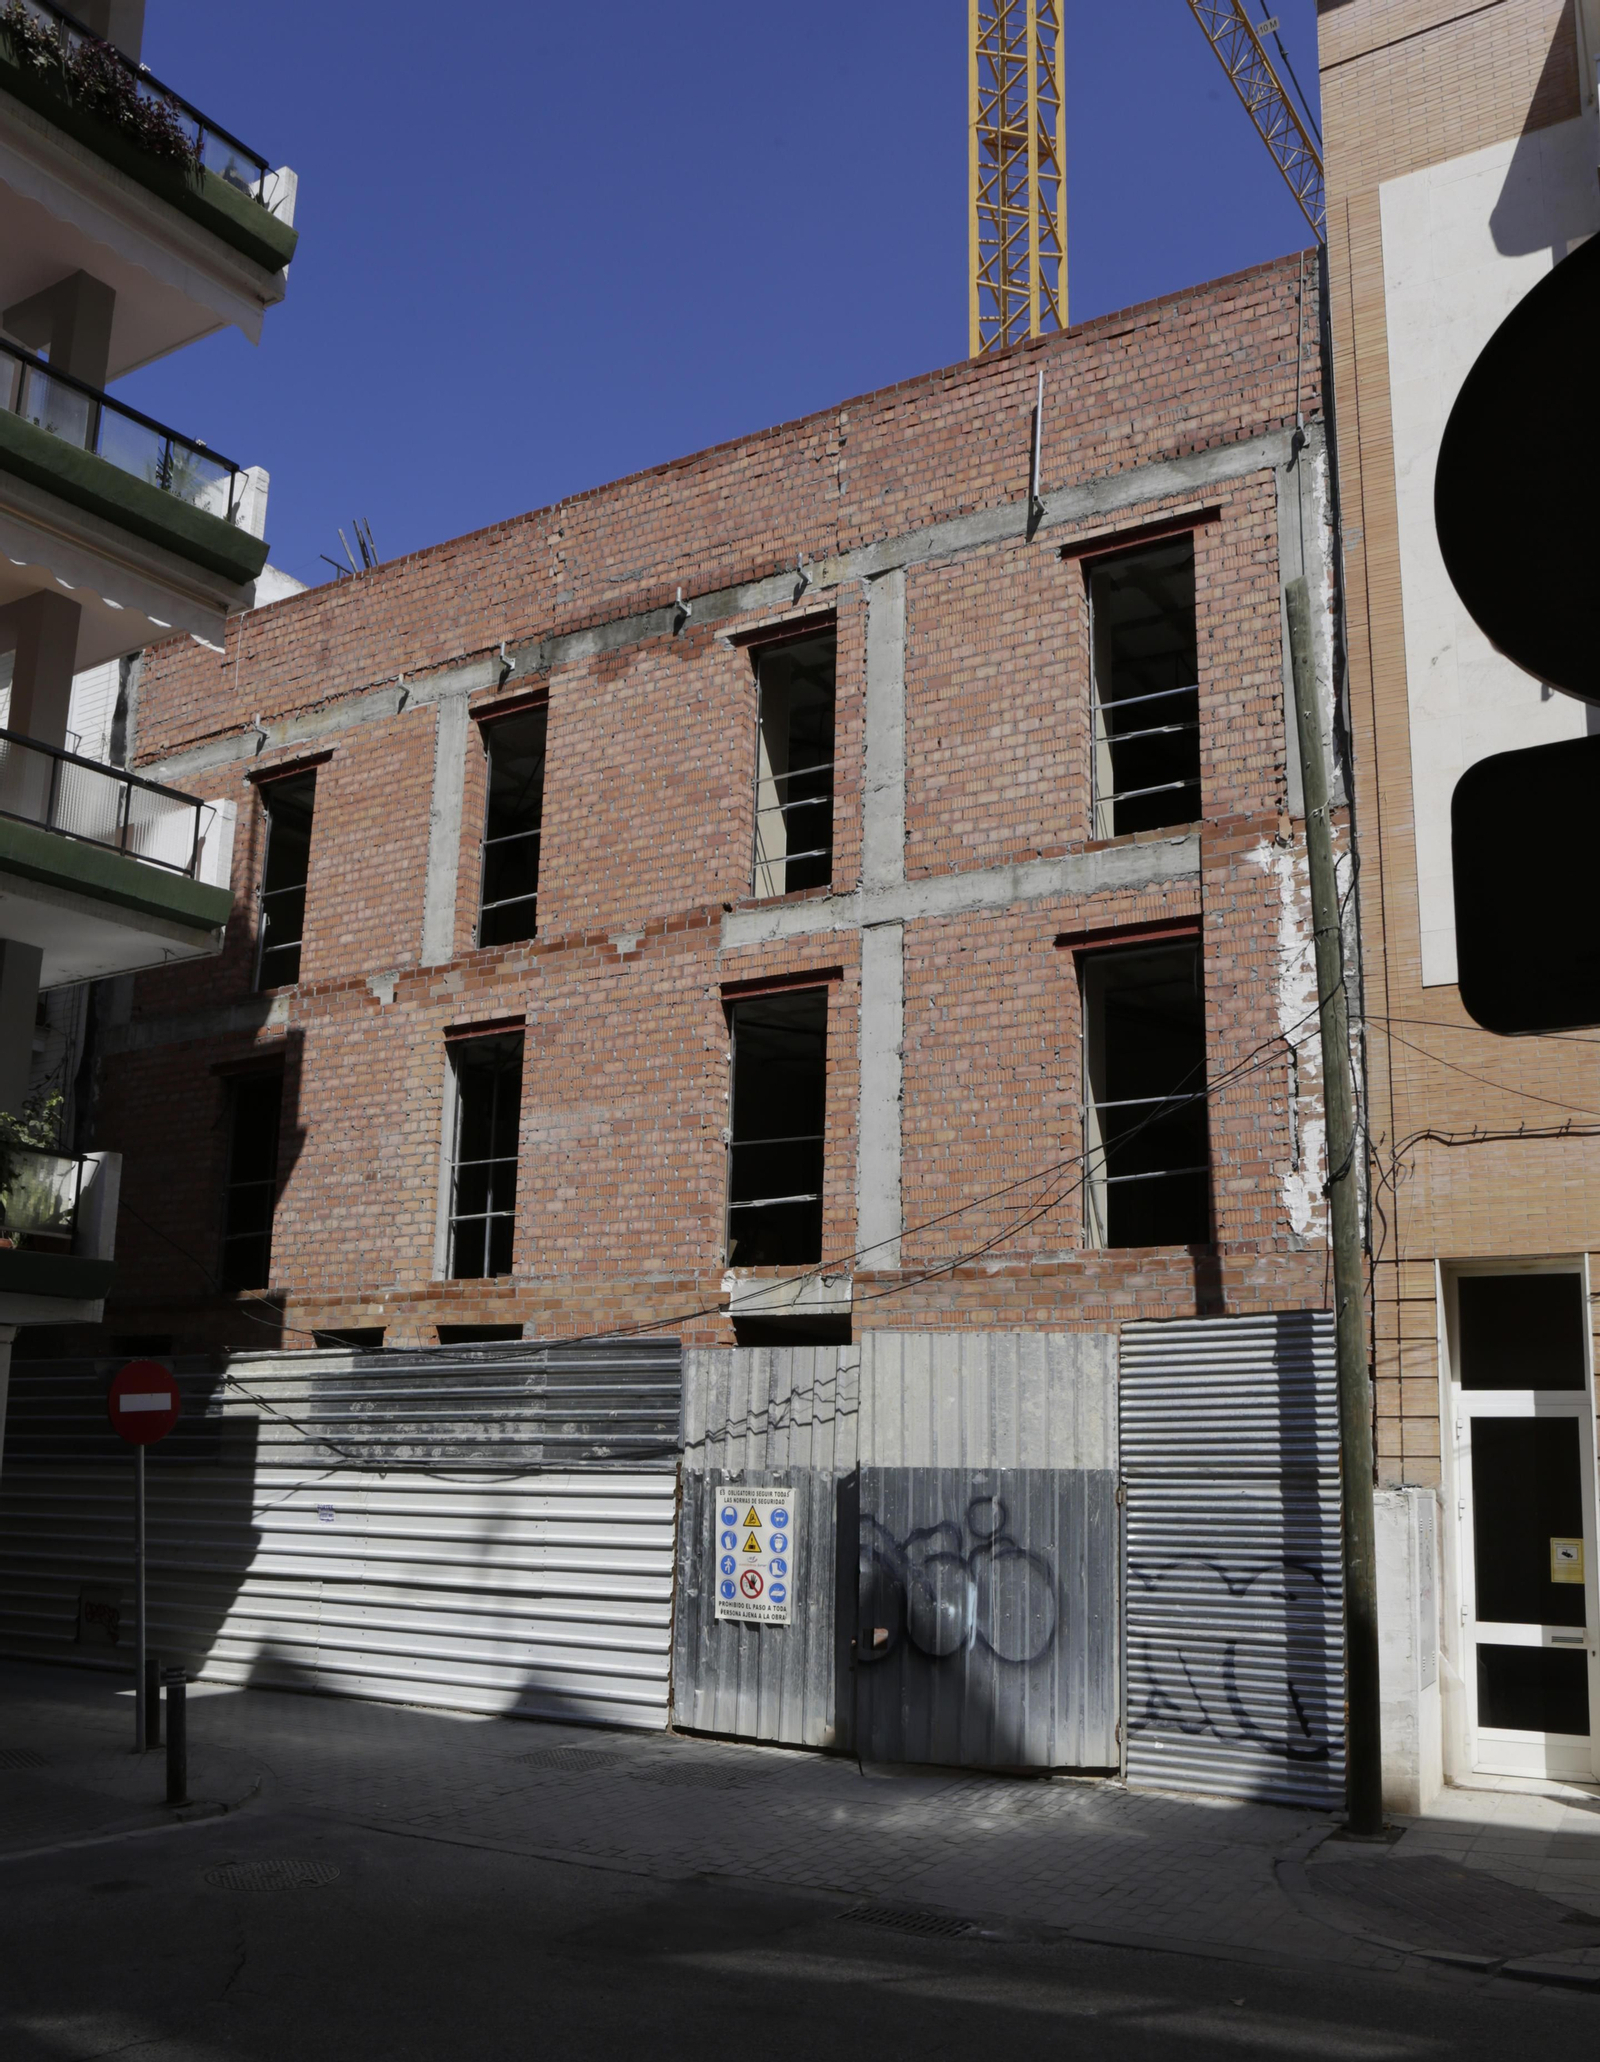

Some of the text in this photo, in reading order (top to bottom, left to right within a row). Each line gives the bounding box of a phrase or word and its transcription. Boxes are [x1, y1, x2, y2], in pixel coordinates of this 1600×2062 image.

[1260, 20, 1278, 34] 10 M
[718, 1600, 745, 1609] PROHIBIDO
[720, 1608, 741, 1617] PERSONA
